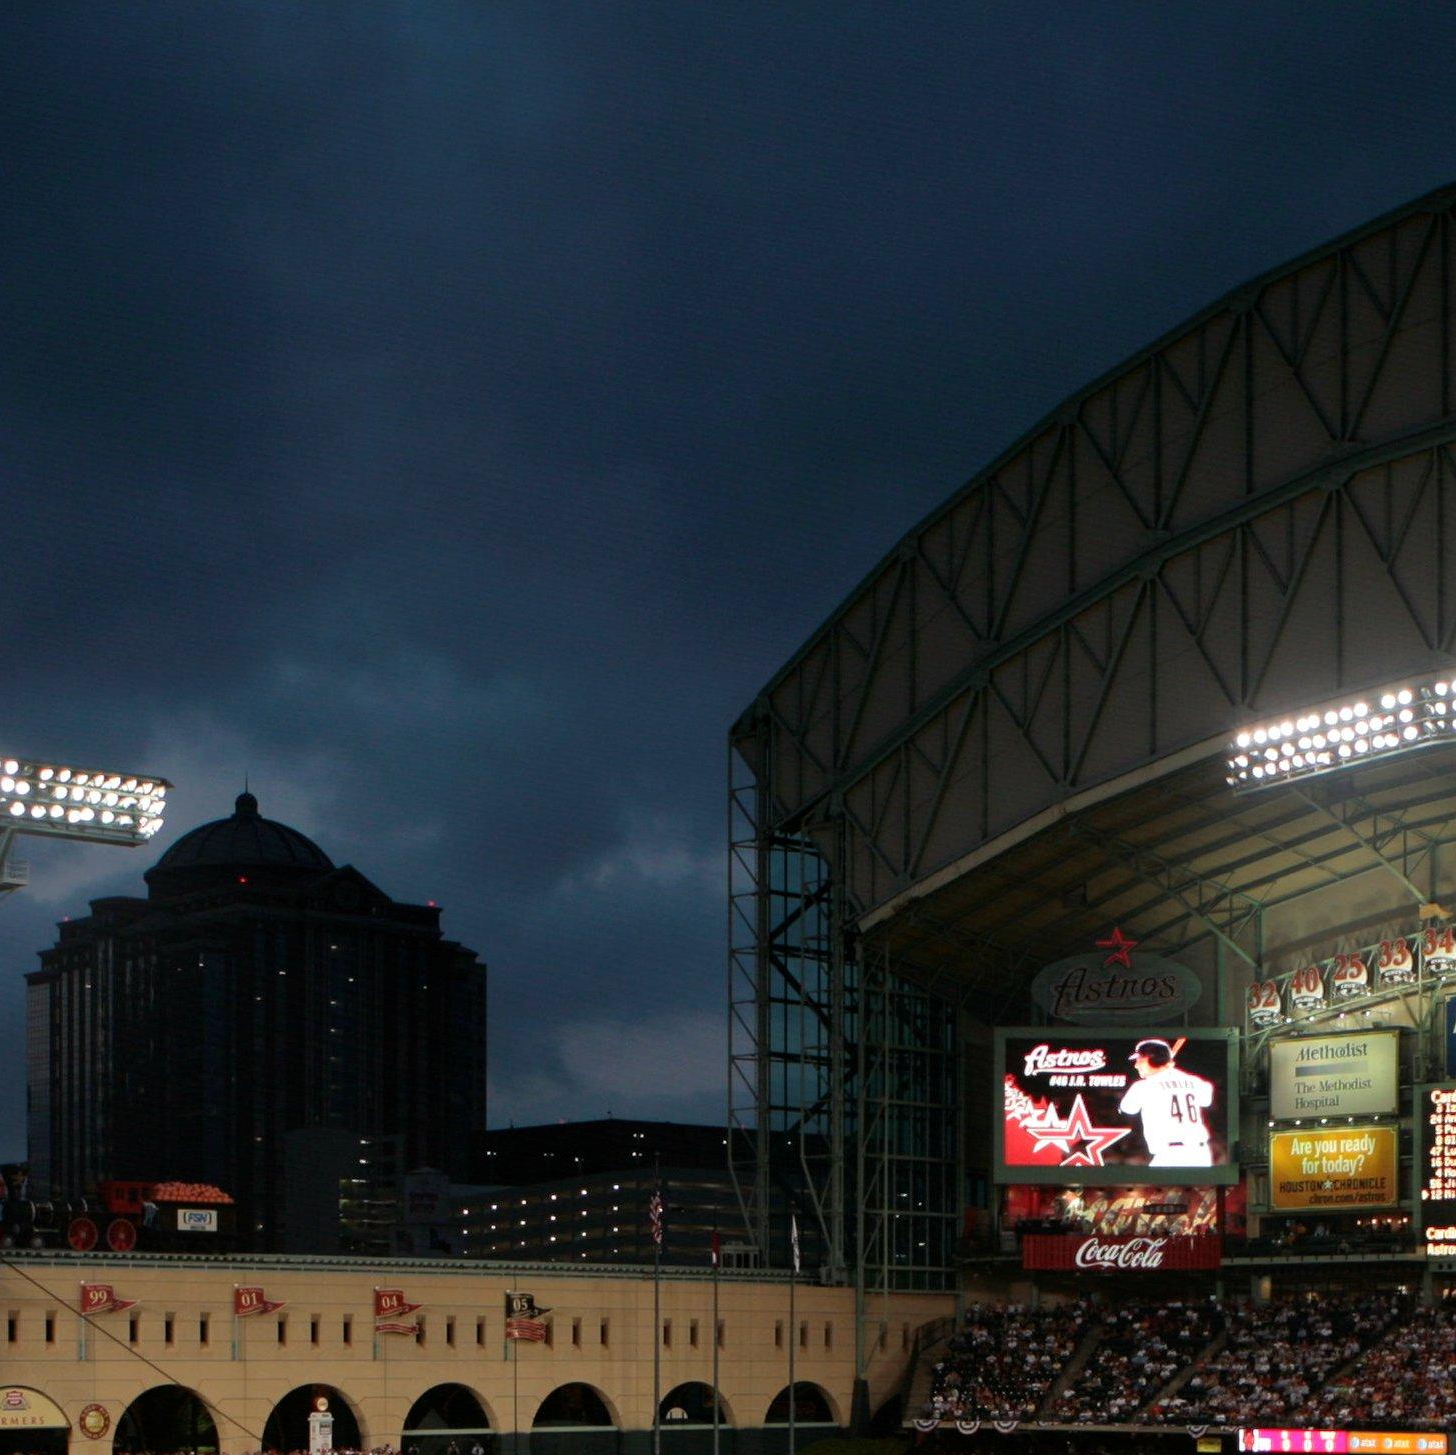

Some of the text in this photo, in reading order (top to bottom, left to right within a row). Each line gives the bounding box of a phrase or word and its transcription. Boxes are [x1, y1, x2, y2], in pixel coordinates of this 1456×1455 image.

[1378, 937, 1408, 968] 33
[1423, 927, 1454, 956] 34
[1334, 952, 1362, 980] 25
[1053, 967, 1178, 1016] Astros
[1249, 980, 1278, 1010] 32
[1291, 967, 1320, 995] 40
[1023, 1042, 1107, 1076] Astros
[1296, 1042, 1368, 1062] Methodist
[1089, 1075, 1126, 1087] TOWLES
[1295, 1077, 1373, 1095] The Methodist
[1170, 1092, 1198, 1123] 46
[1295, 1096, 1340, 1111] Hospital
[1291, 1134, 1376, 1158] Are you ready
[1302, 1154, 1365, 1177] for today?
[1280, 1177, 1386, 1193] HOUSTON CHRONICLE
[1075, 1237, 1167, 1269] Coca-Cola
[89, 1290, 107, 1304] 99
